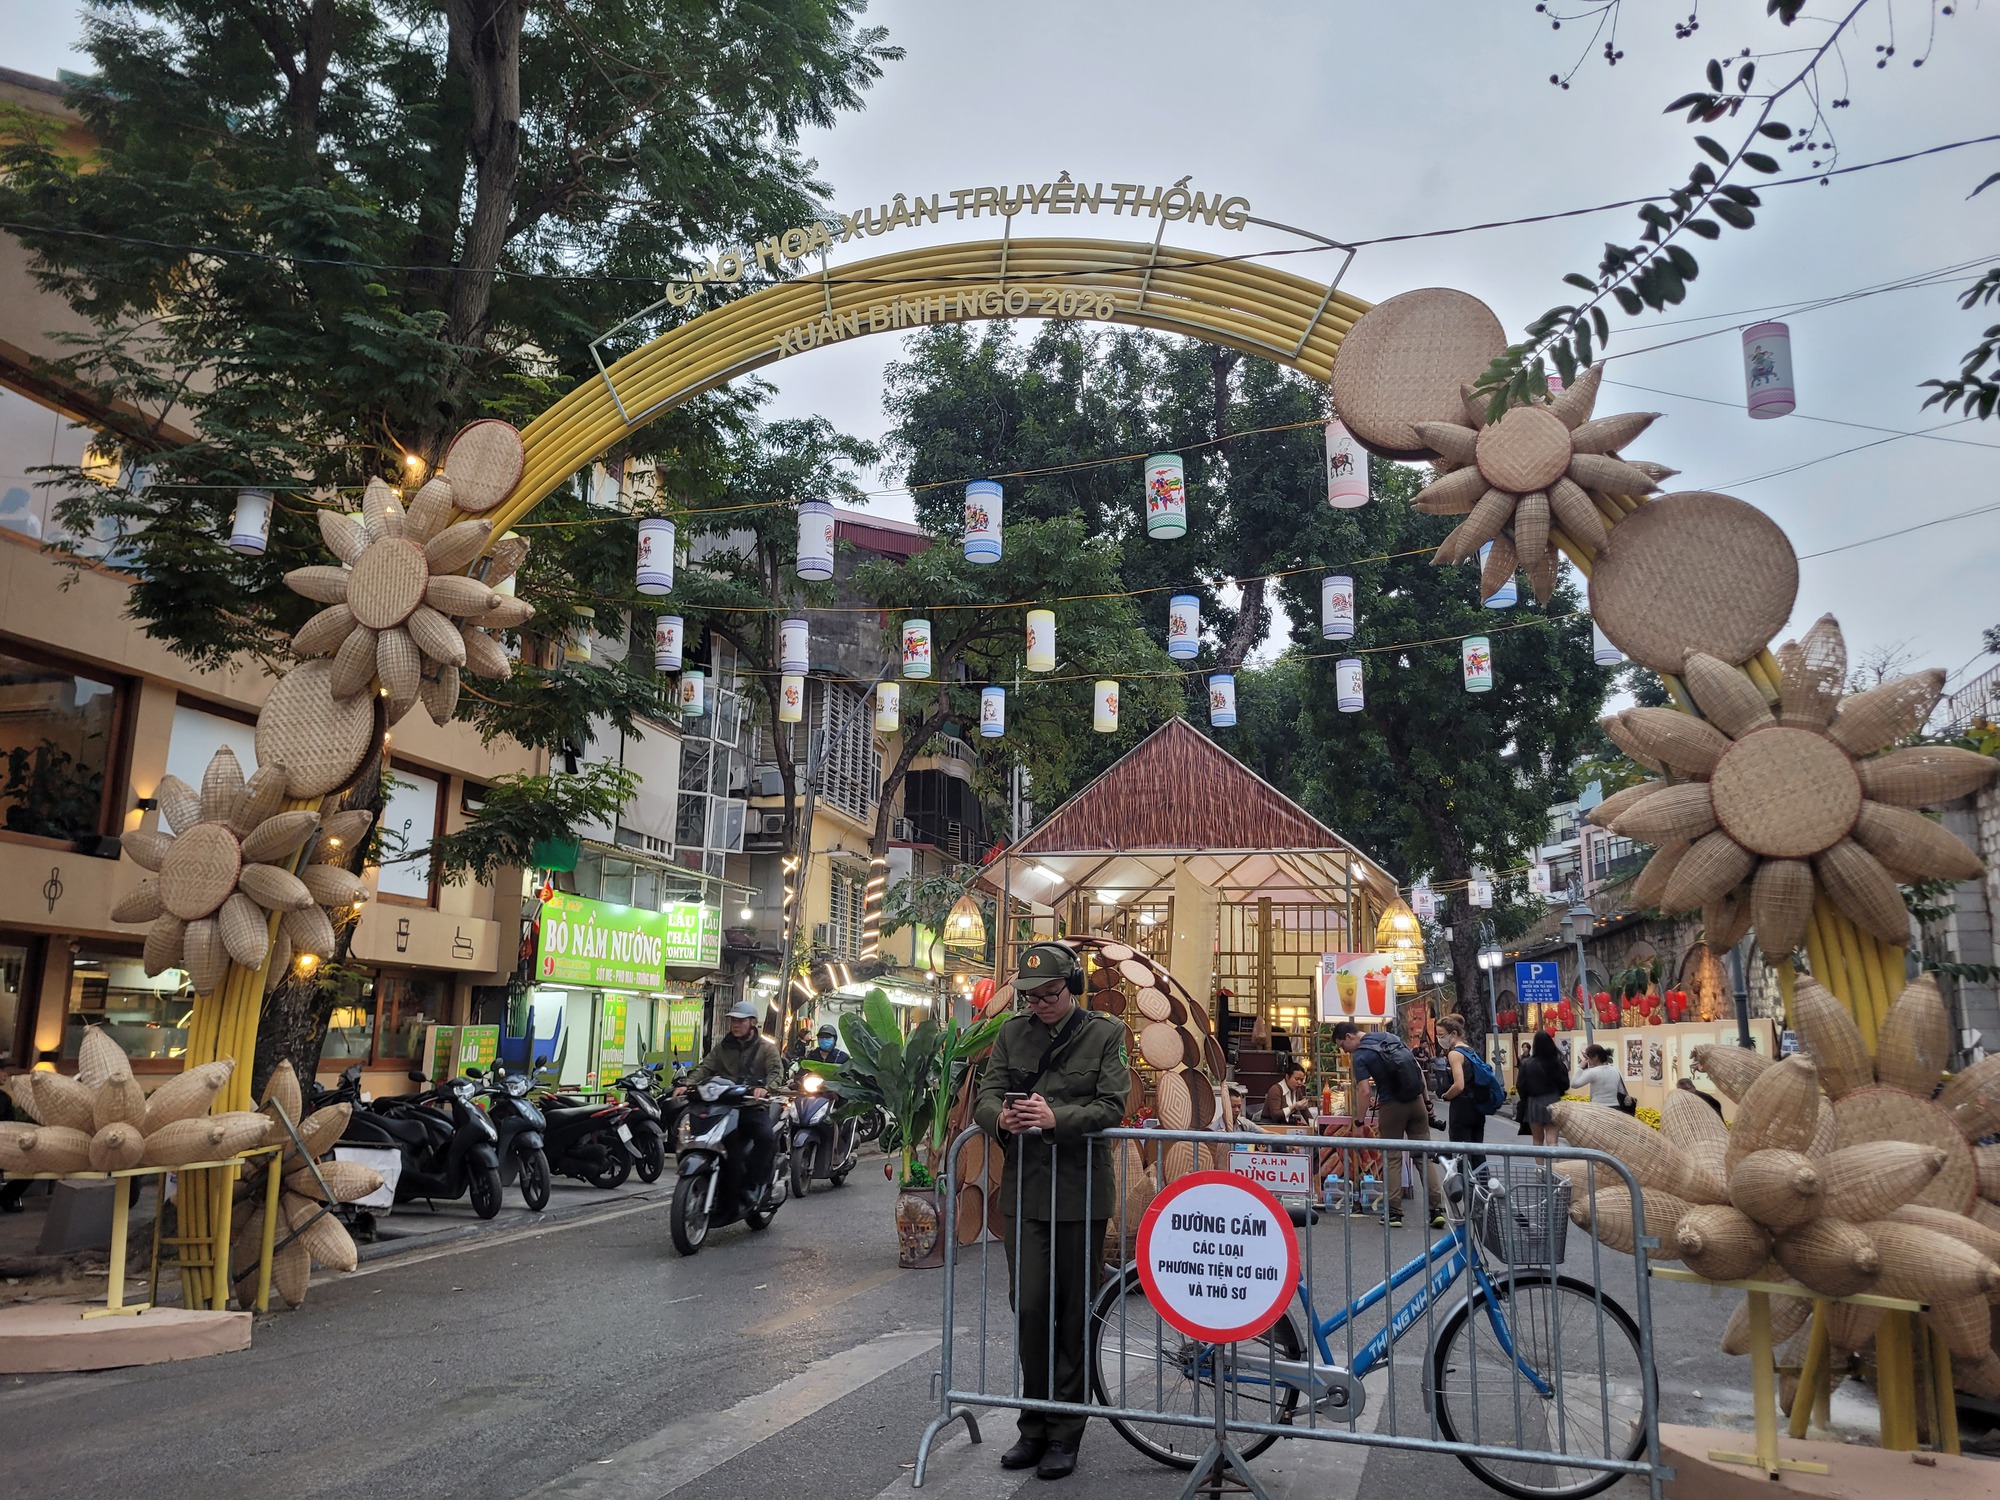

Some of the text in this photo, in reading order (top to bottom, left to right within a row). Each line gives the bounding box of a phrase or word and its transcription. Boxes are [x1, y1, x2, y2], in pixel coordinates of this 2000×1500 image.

[755, 221, 833, 269] HOA
[841, 192, 940, 243] XUÂN
[950, 169, 1103, 220] TRUYỀN
[1111, 175, 1251, 232] THỐNG
[773, 286, 1116, 360] XUÂN BÍNH NGỌ 2026
[544, 909, 662, 967] BÒ NẦM NƯỚNG
[666, 928, 697, 946] THÁI
[542, 955, 556, 977] 9
[1530, 964, 1543, 980] P
[1250, 1157, 1287, 1166] C.A.H.N
[1279, 1171, 1305, 1186] LẠI
[1171, 1210, 1267, 1237] ĐƯỜNG CẤM
[1192, 1239, 1244, 1260] CÁC LOẠI
[1158, 1260, 1278, 1281] PHƯƠNG TIỆN CƠ GIỚI
[1188, 1281, 1247, 1300] VÀ THÔ SƠ
